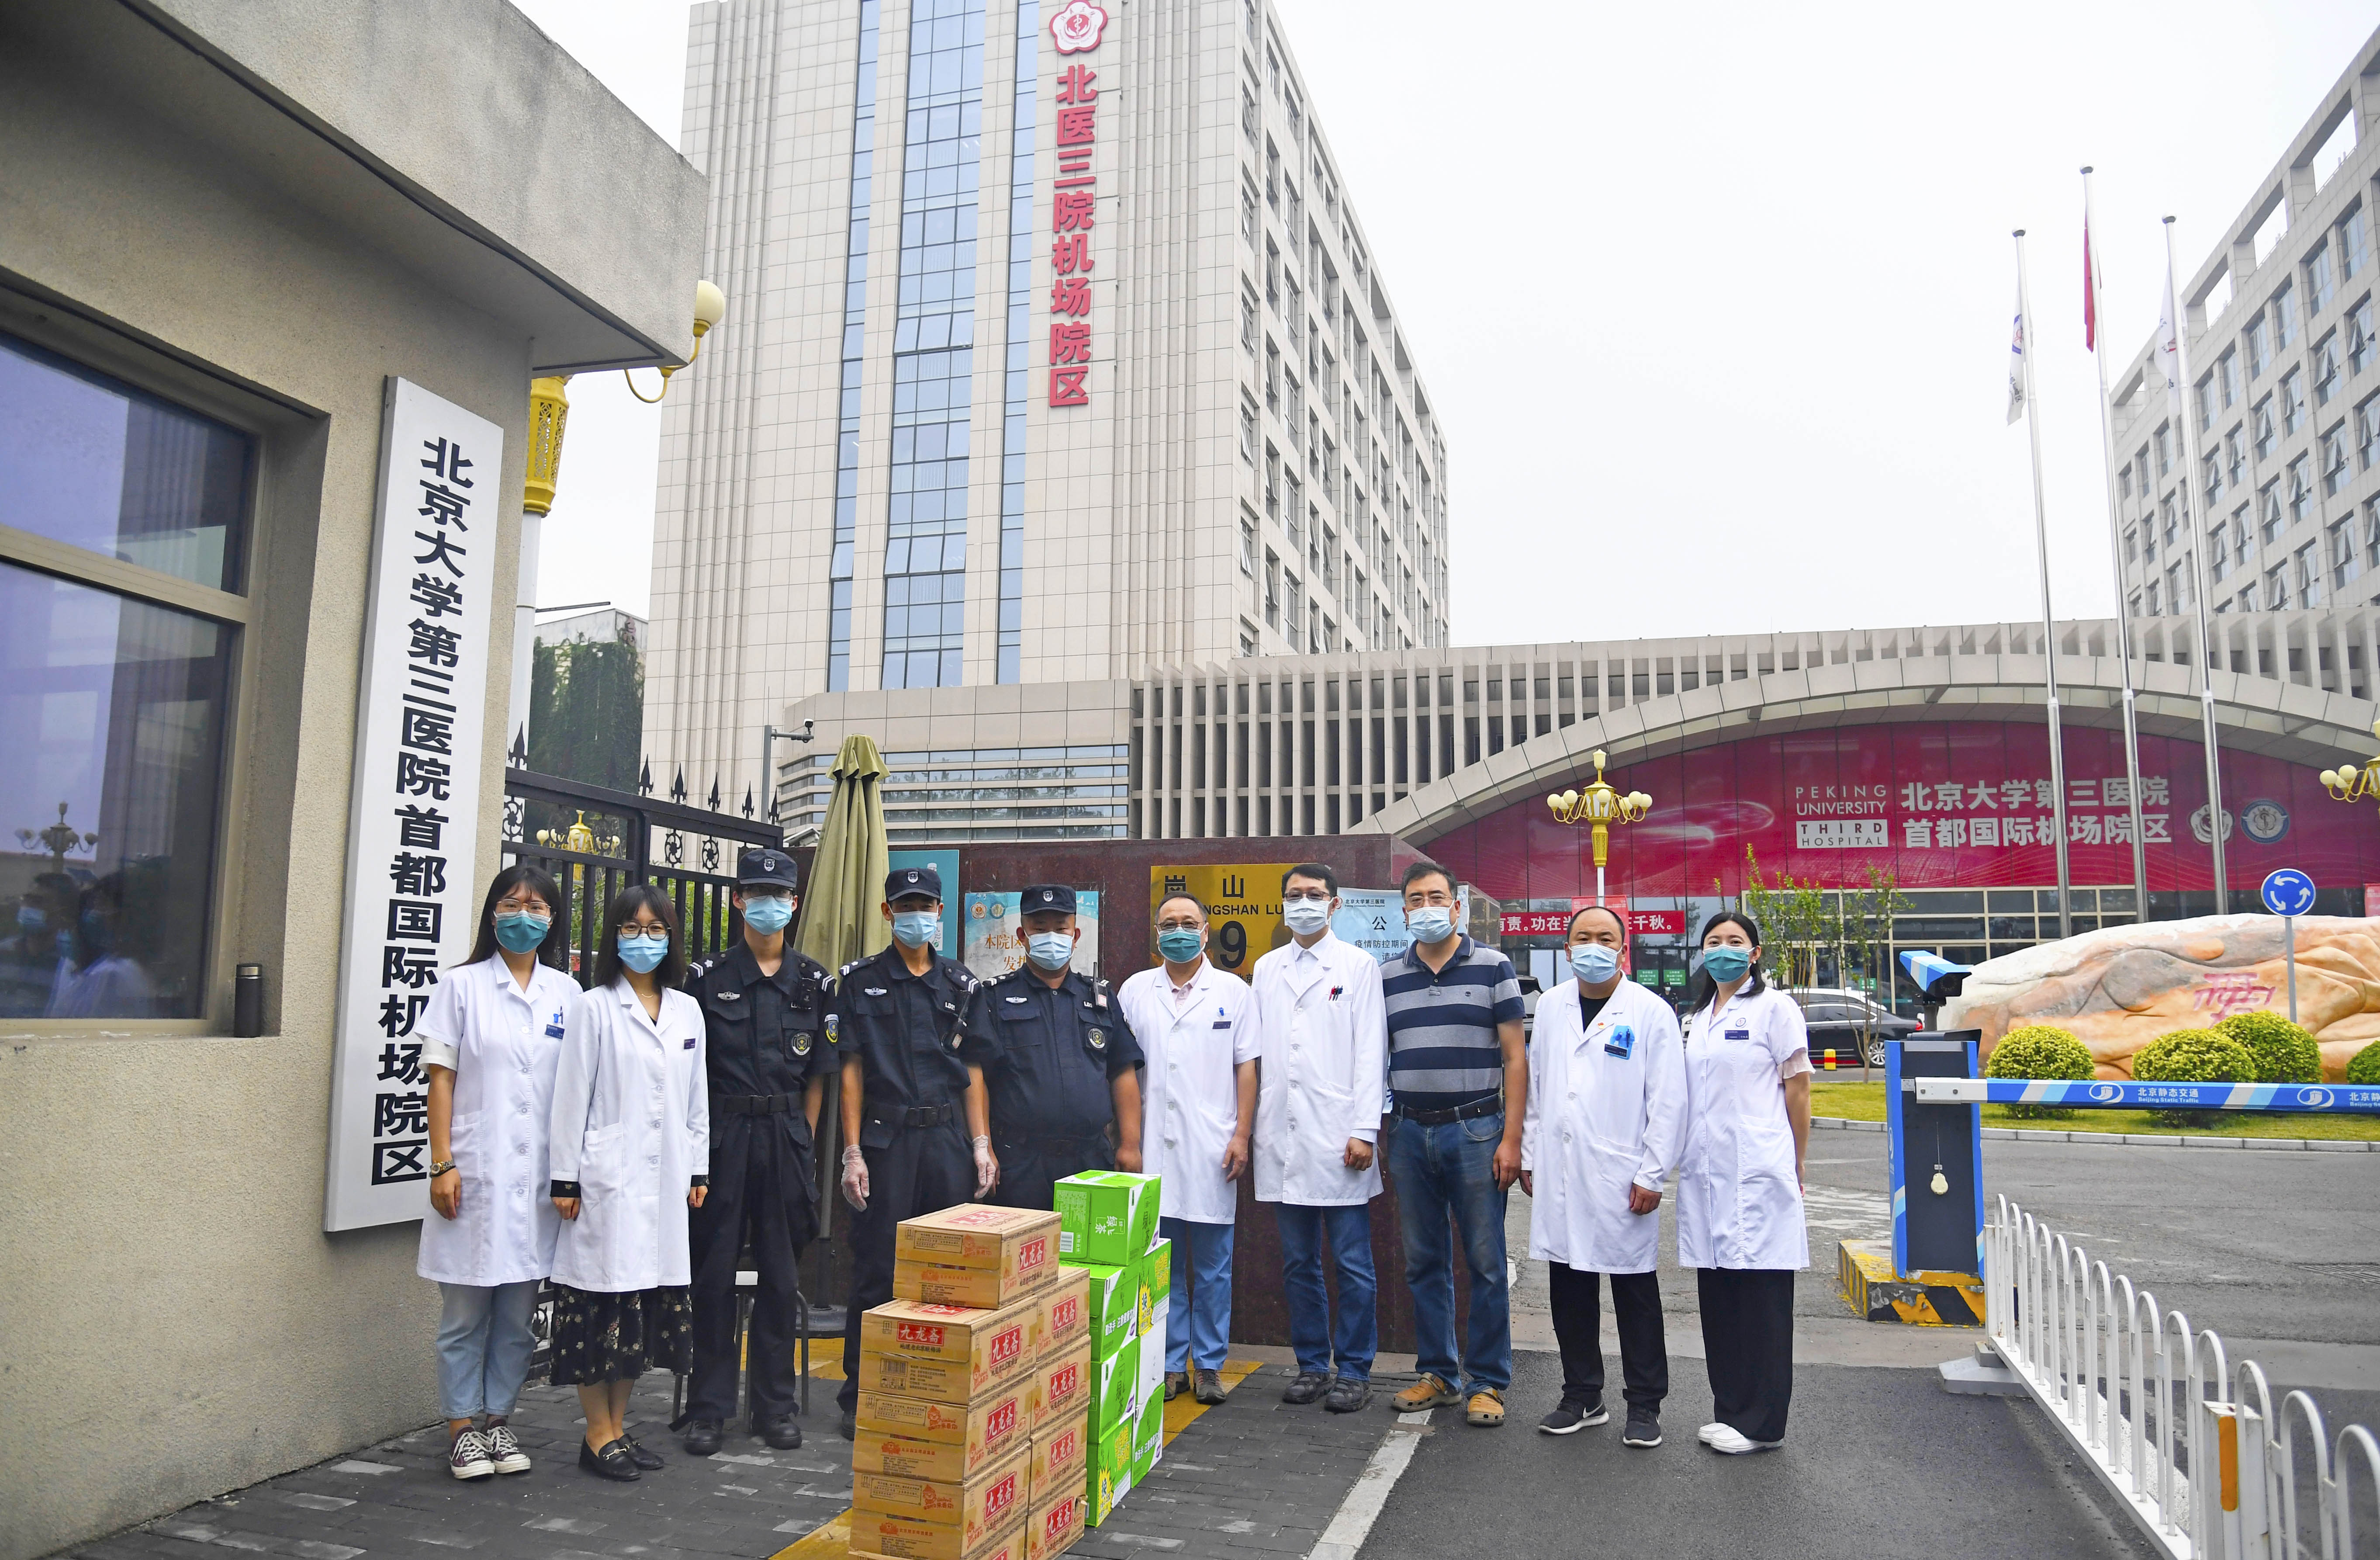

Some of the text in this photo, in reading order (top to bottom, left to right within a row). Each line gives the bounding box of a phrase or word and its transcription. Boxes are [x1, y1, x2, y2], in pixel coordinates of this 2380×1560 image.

[1049, 63, 1099, 408] 北医三院机场院区
[1795, 784, 1887, 799] PEKING
[1901, 776, 2169, 812] 北京大学第三医院
[371, 437, 474, 1185] 北京大学第三医院首都国际机场院区
[1796, 801, 1887, 816] UNIVERSITY
[1801, 822, 1882, 835] THIRD
[1802, 836, 1882, 846] HOSPITAL
[1903, 814, 2172, 848] 首都国际机场院区
[1164, 874, 1284, 899] 岗山
[1204, 904, 1259, 915] NGSHAN
[1220, 920, 1247, 969] 9
[1355, 939, 1408, 948] 疫情防控期间
[2138, 1087, 2199, 1098] 北京静态交通
[1019, 1241, 1044, 1271] 九龙斋
[1054, 1301, 1075, 1329] 九龙斋
[900, 1325, 940, 1343] 九龙斋
[992, 1331, 1019, 1362] 九龙斋
[1051, 1368, 1075, 1398] 九龙斋
[988, 1405, 1014, 1439] 九龙斋
[1051, 1434, 1074, 1467] 九龙斋
[986, 1480, 1014, 1517] 九龙斋
[1047, 1503, 1072, 1537] 九龙斋
